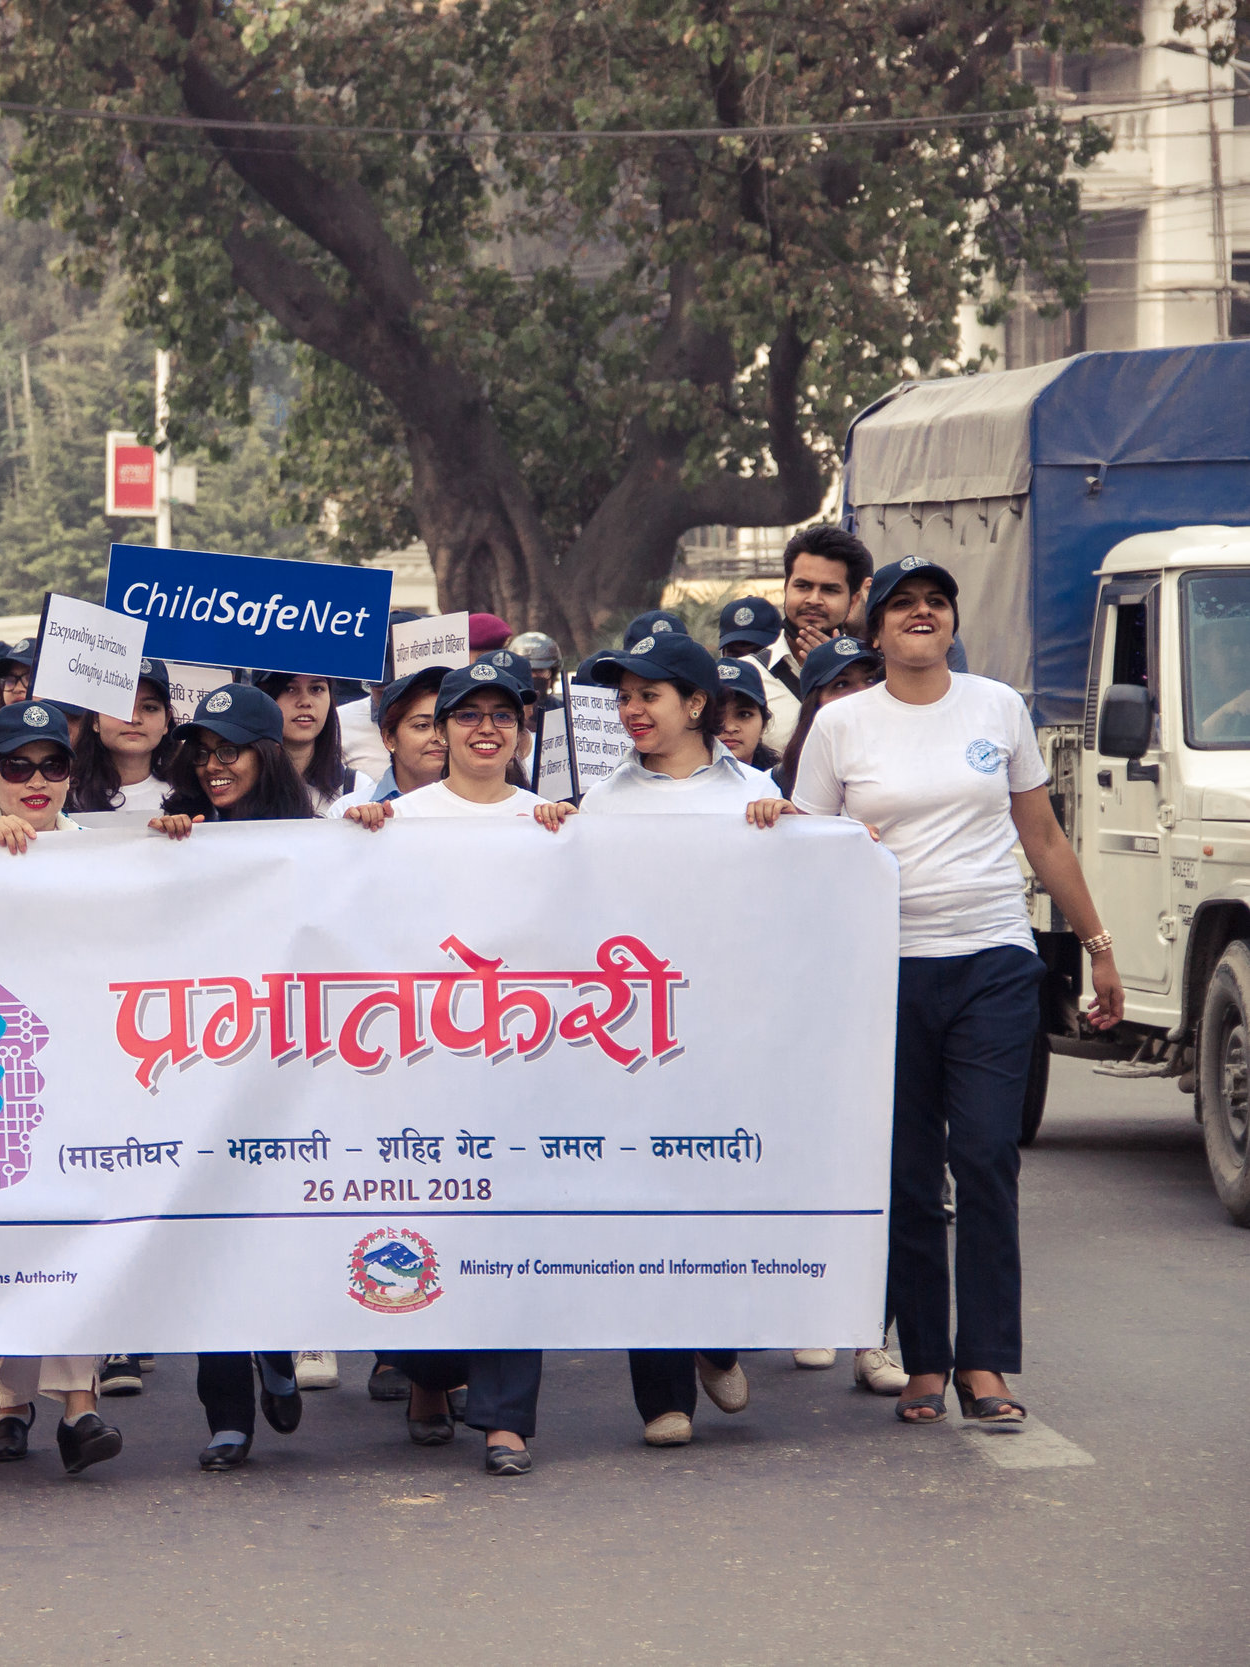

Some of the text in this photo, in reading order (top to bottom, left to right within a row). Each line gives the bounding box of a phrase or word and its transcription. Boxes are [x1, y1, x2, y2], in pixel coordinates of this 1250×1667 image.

[123, 582, 370, 637] ChildSafeNet
[48, 621, 127, 657] Expanding Horizons
[68, 653, 135, 692] Changing Attitudes
[107, 934, 690, 1096] प्रभातफेरी
[227, 1129, 331, 1166] भद्रकाली
[377, 1128, 445, 1166] शहिद
[456, 1129, 496, 1161] गेट
[540, 1135, 605, 1162] जमल
[650, 1128, 764, 1164] कमलादी)
[304, 1178, 492, 1202] 26 APRIL 2018
[14, 1270, 78, 1284] Authority
[460, 1259, 828, 1279] Ministry of Communication and Information Technology
